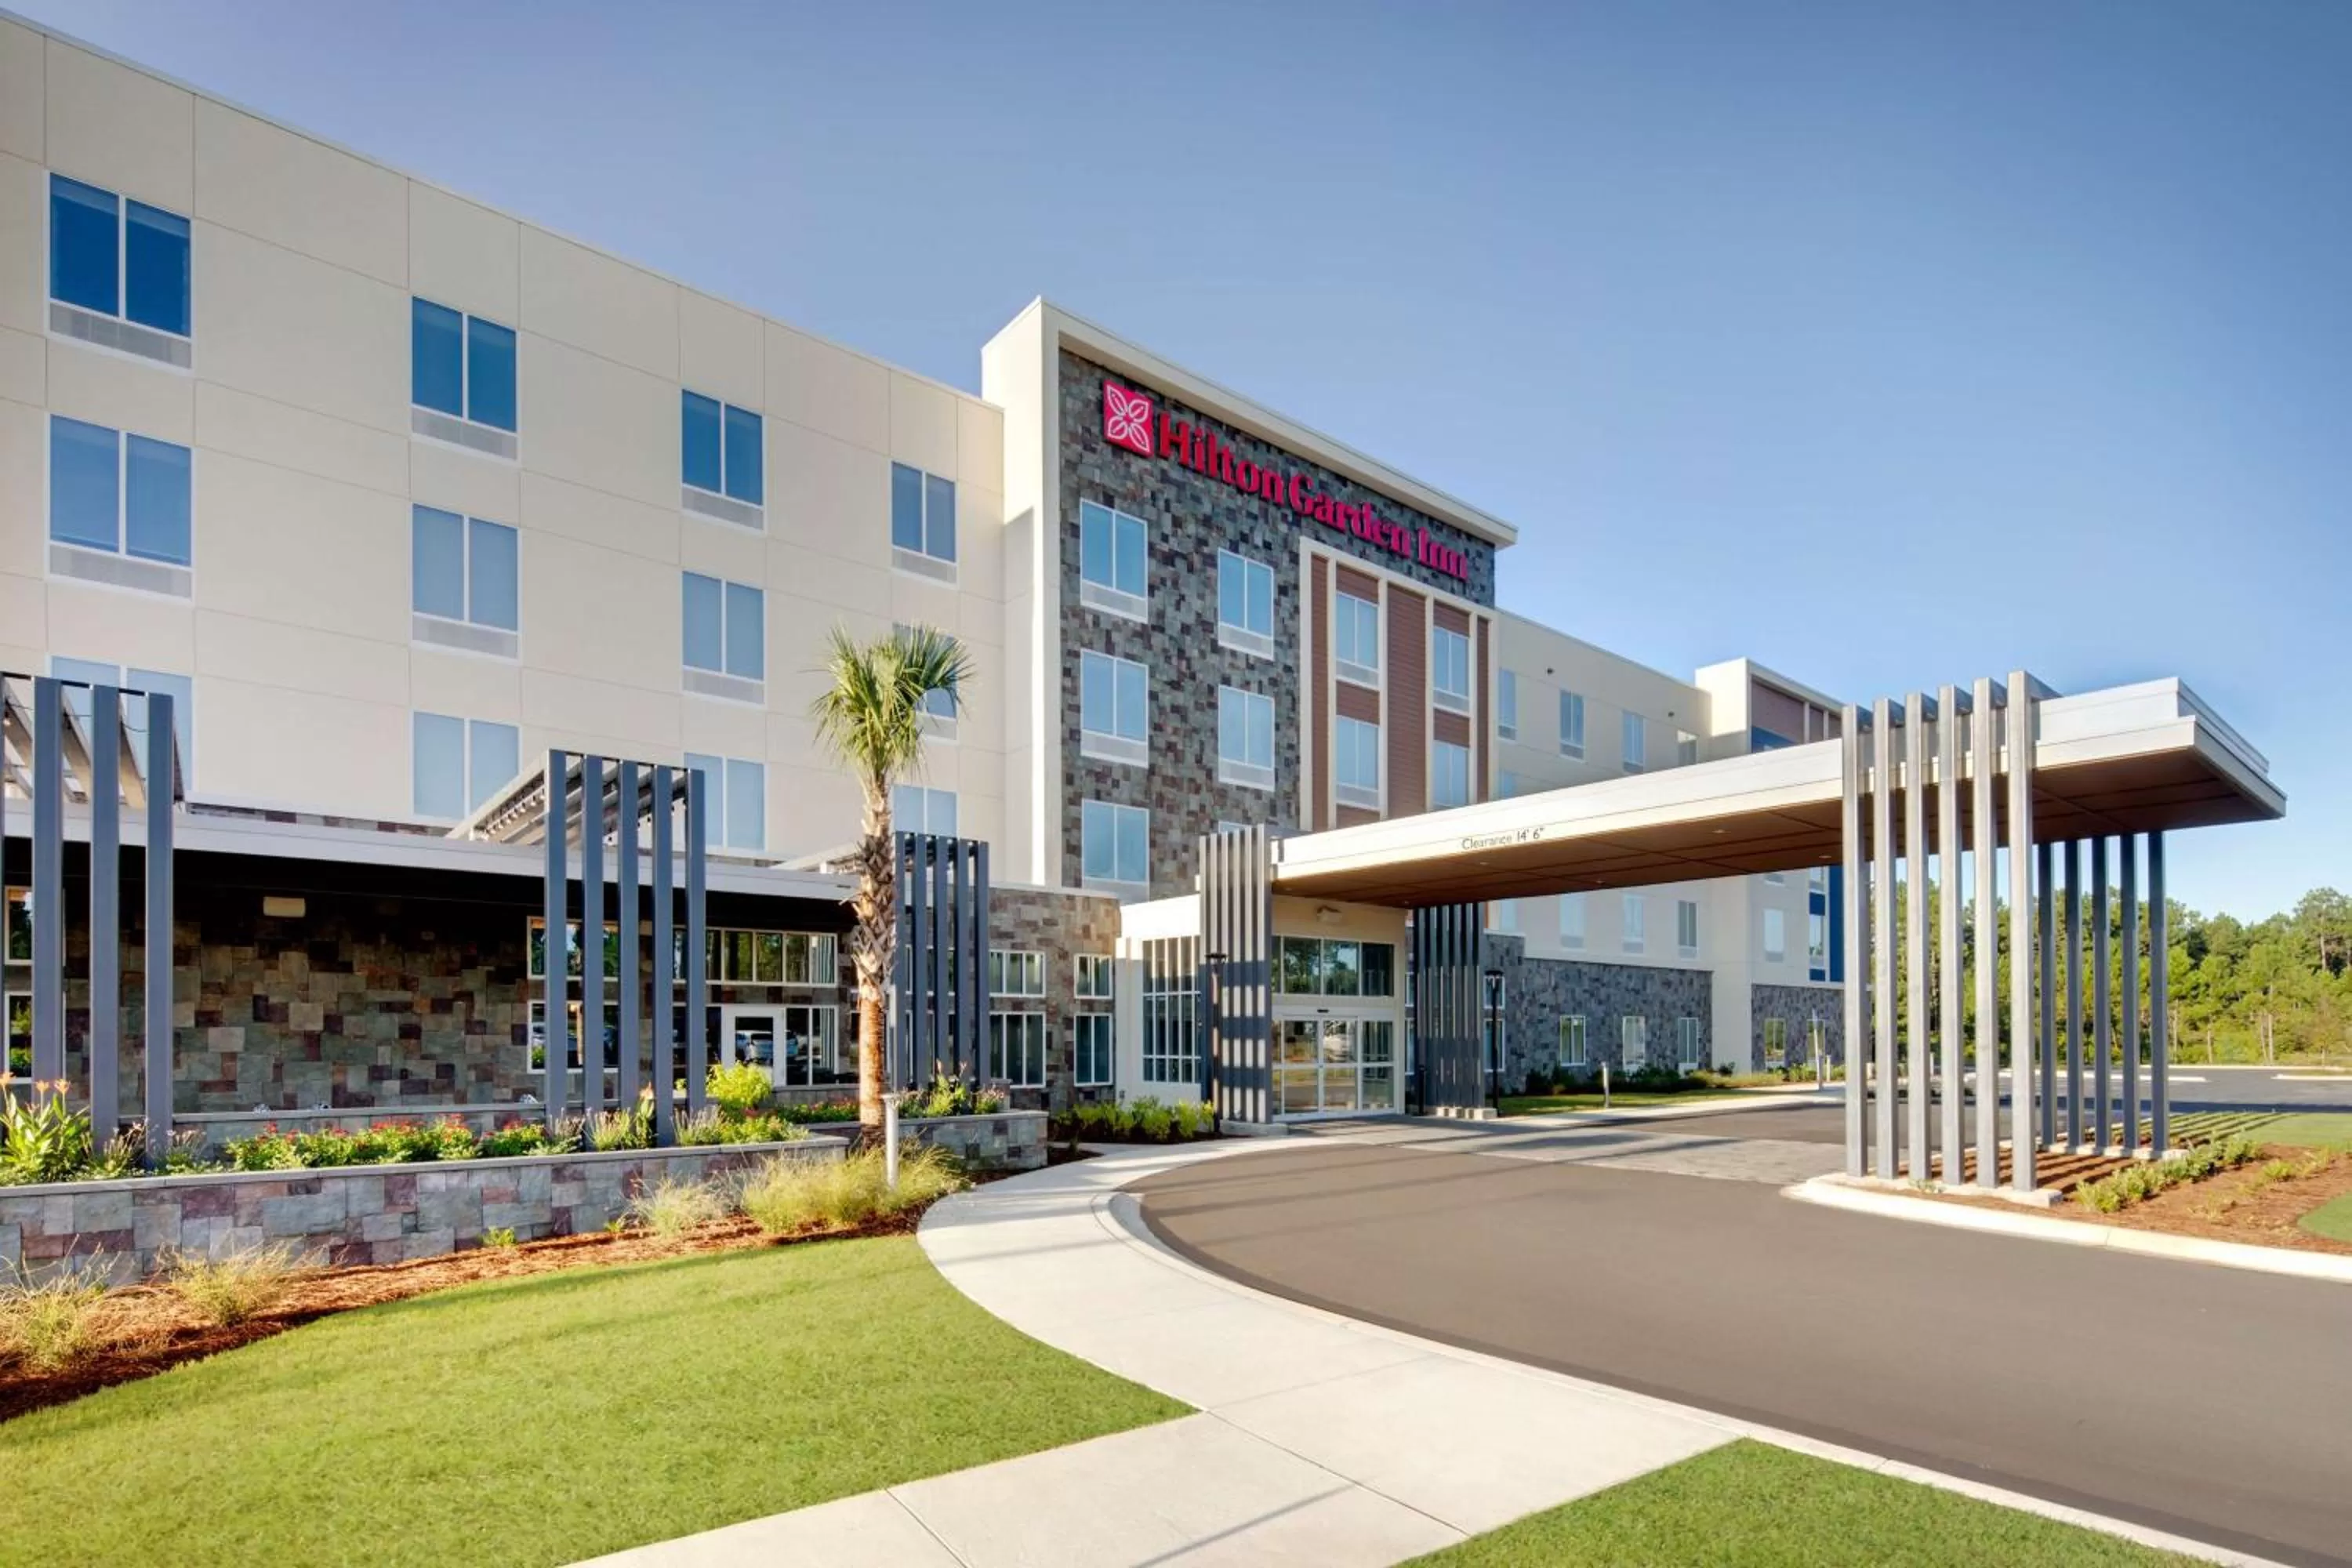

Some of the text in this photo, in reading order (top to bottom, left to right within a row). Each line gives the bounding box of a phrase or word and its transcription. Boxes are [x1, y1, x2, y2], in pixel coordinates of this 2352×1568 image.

[1159, 411, 1468, 582] Hilton Garden Inn
[1461, 834, 1512, 850] Clearance
